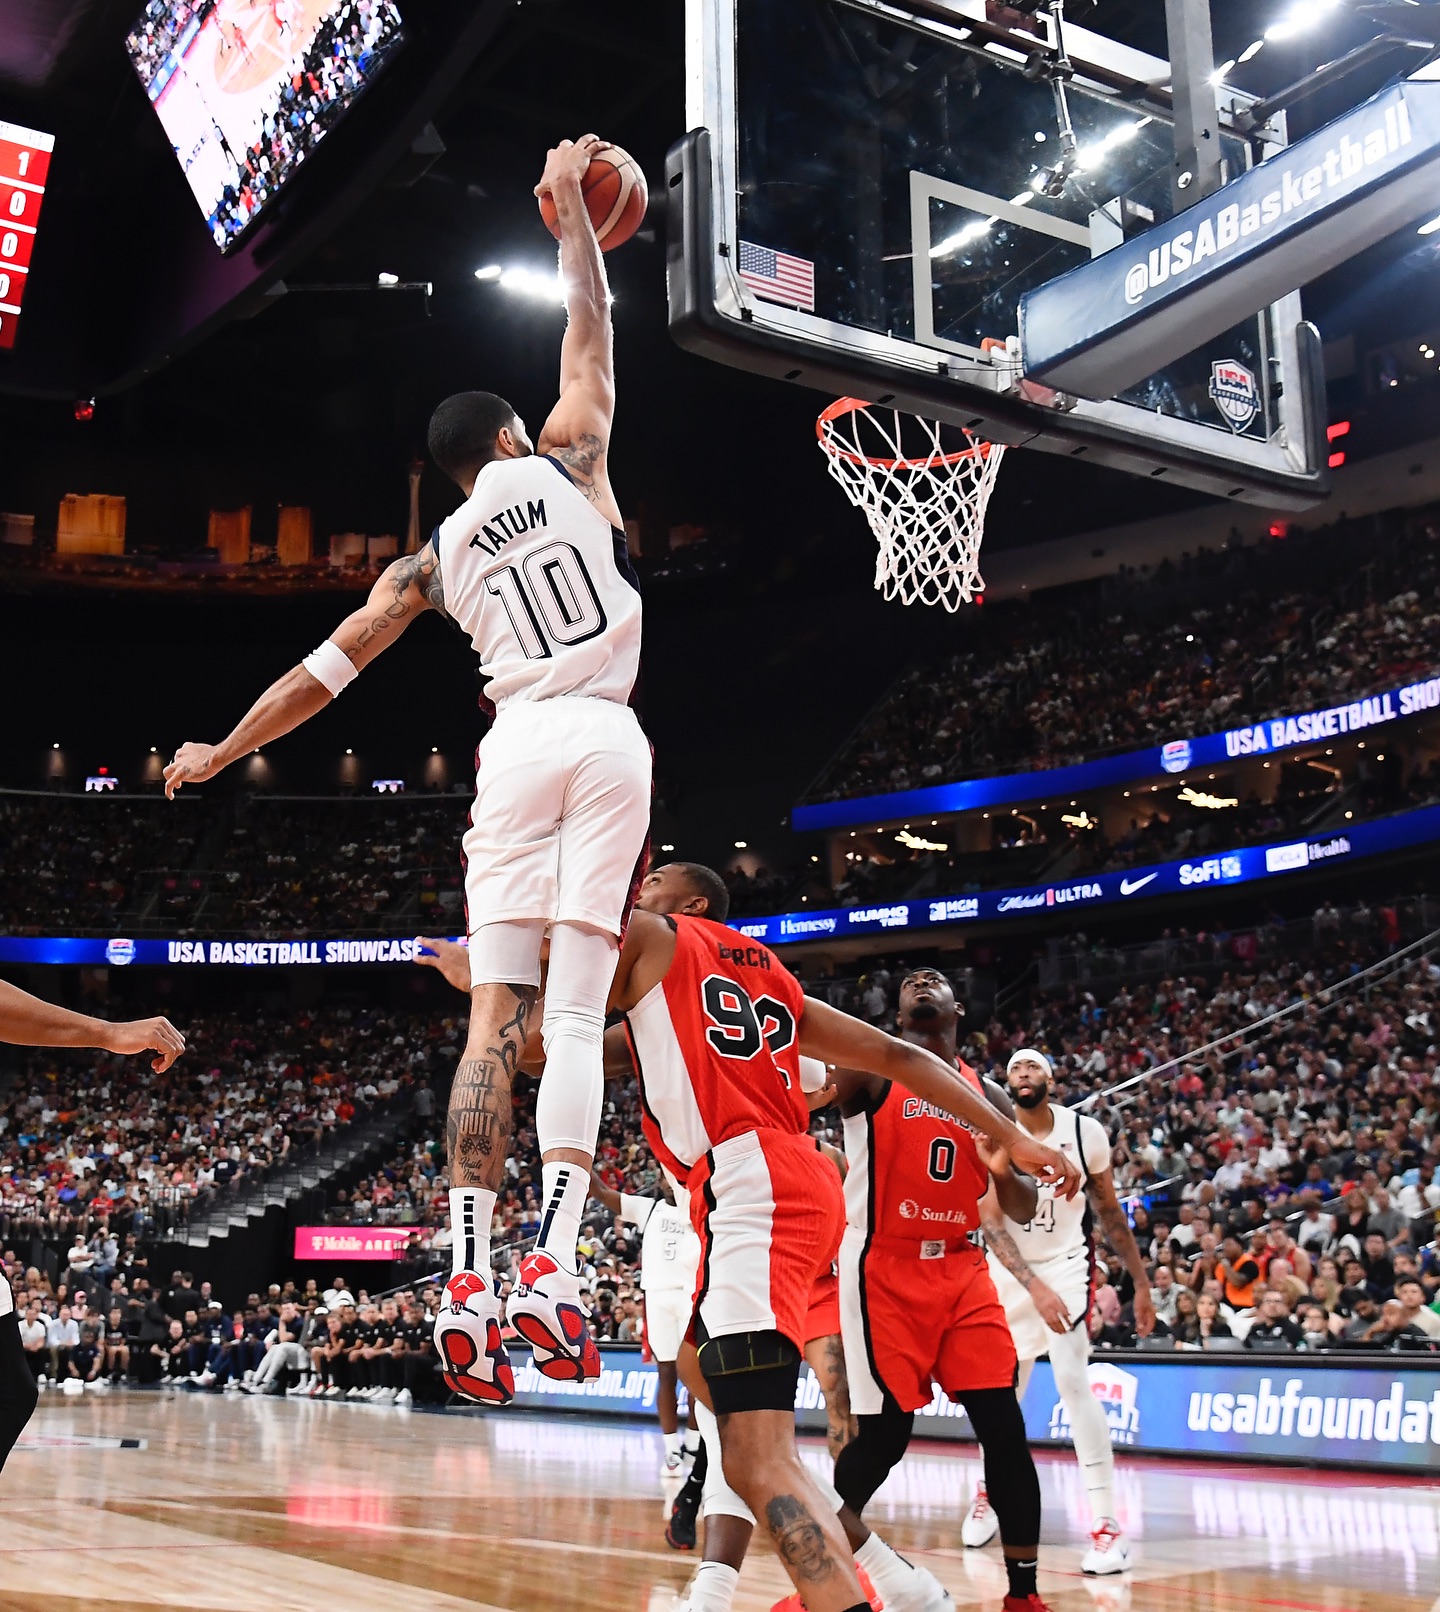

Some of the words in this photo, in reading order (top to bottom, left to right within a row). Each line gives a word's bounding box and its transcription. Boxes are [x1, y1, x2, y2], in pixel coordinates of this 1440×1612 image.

[18, 151, 29, 176] 1
[9, 191, 26, 216] 0
[1125, 99, 1412, 305] @USABasketball
[1, 232, 18, 257] 0
[469, 499, 548, 557] TATUM
[484, 541, 608, 660] 10
[1225, 724, 1268, 757] USA
[1271, 693, 1396, 747] BASKETBALL
[1399, 678, 1440, 715] SHO
[1179, 859, 1220, 885] SoFi
[946, 898, 979, 912] MGM
[1055, 883, 1103, 903] ULTRA
[780, 917, 837, 934] Hennessy
[849, 905, 909, 923] KUMHO
[168, 941, 206, 964] USA
[209, 942, 321, 964] BASKETBALL
[325, 940, 423, 962] SHOWCASE
[927, 1137, 957, 1183] 0
[1187, 1378, 1440, 1444] usabfoundat
